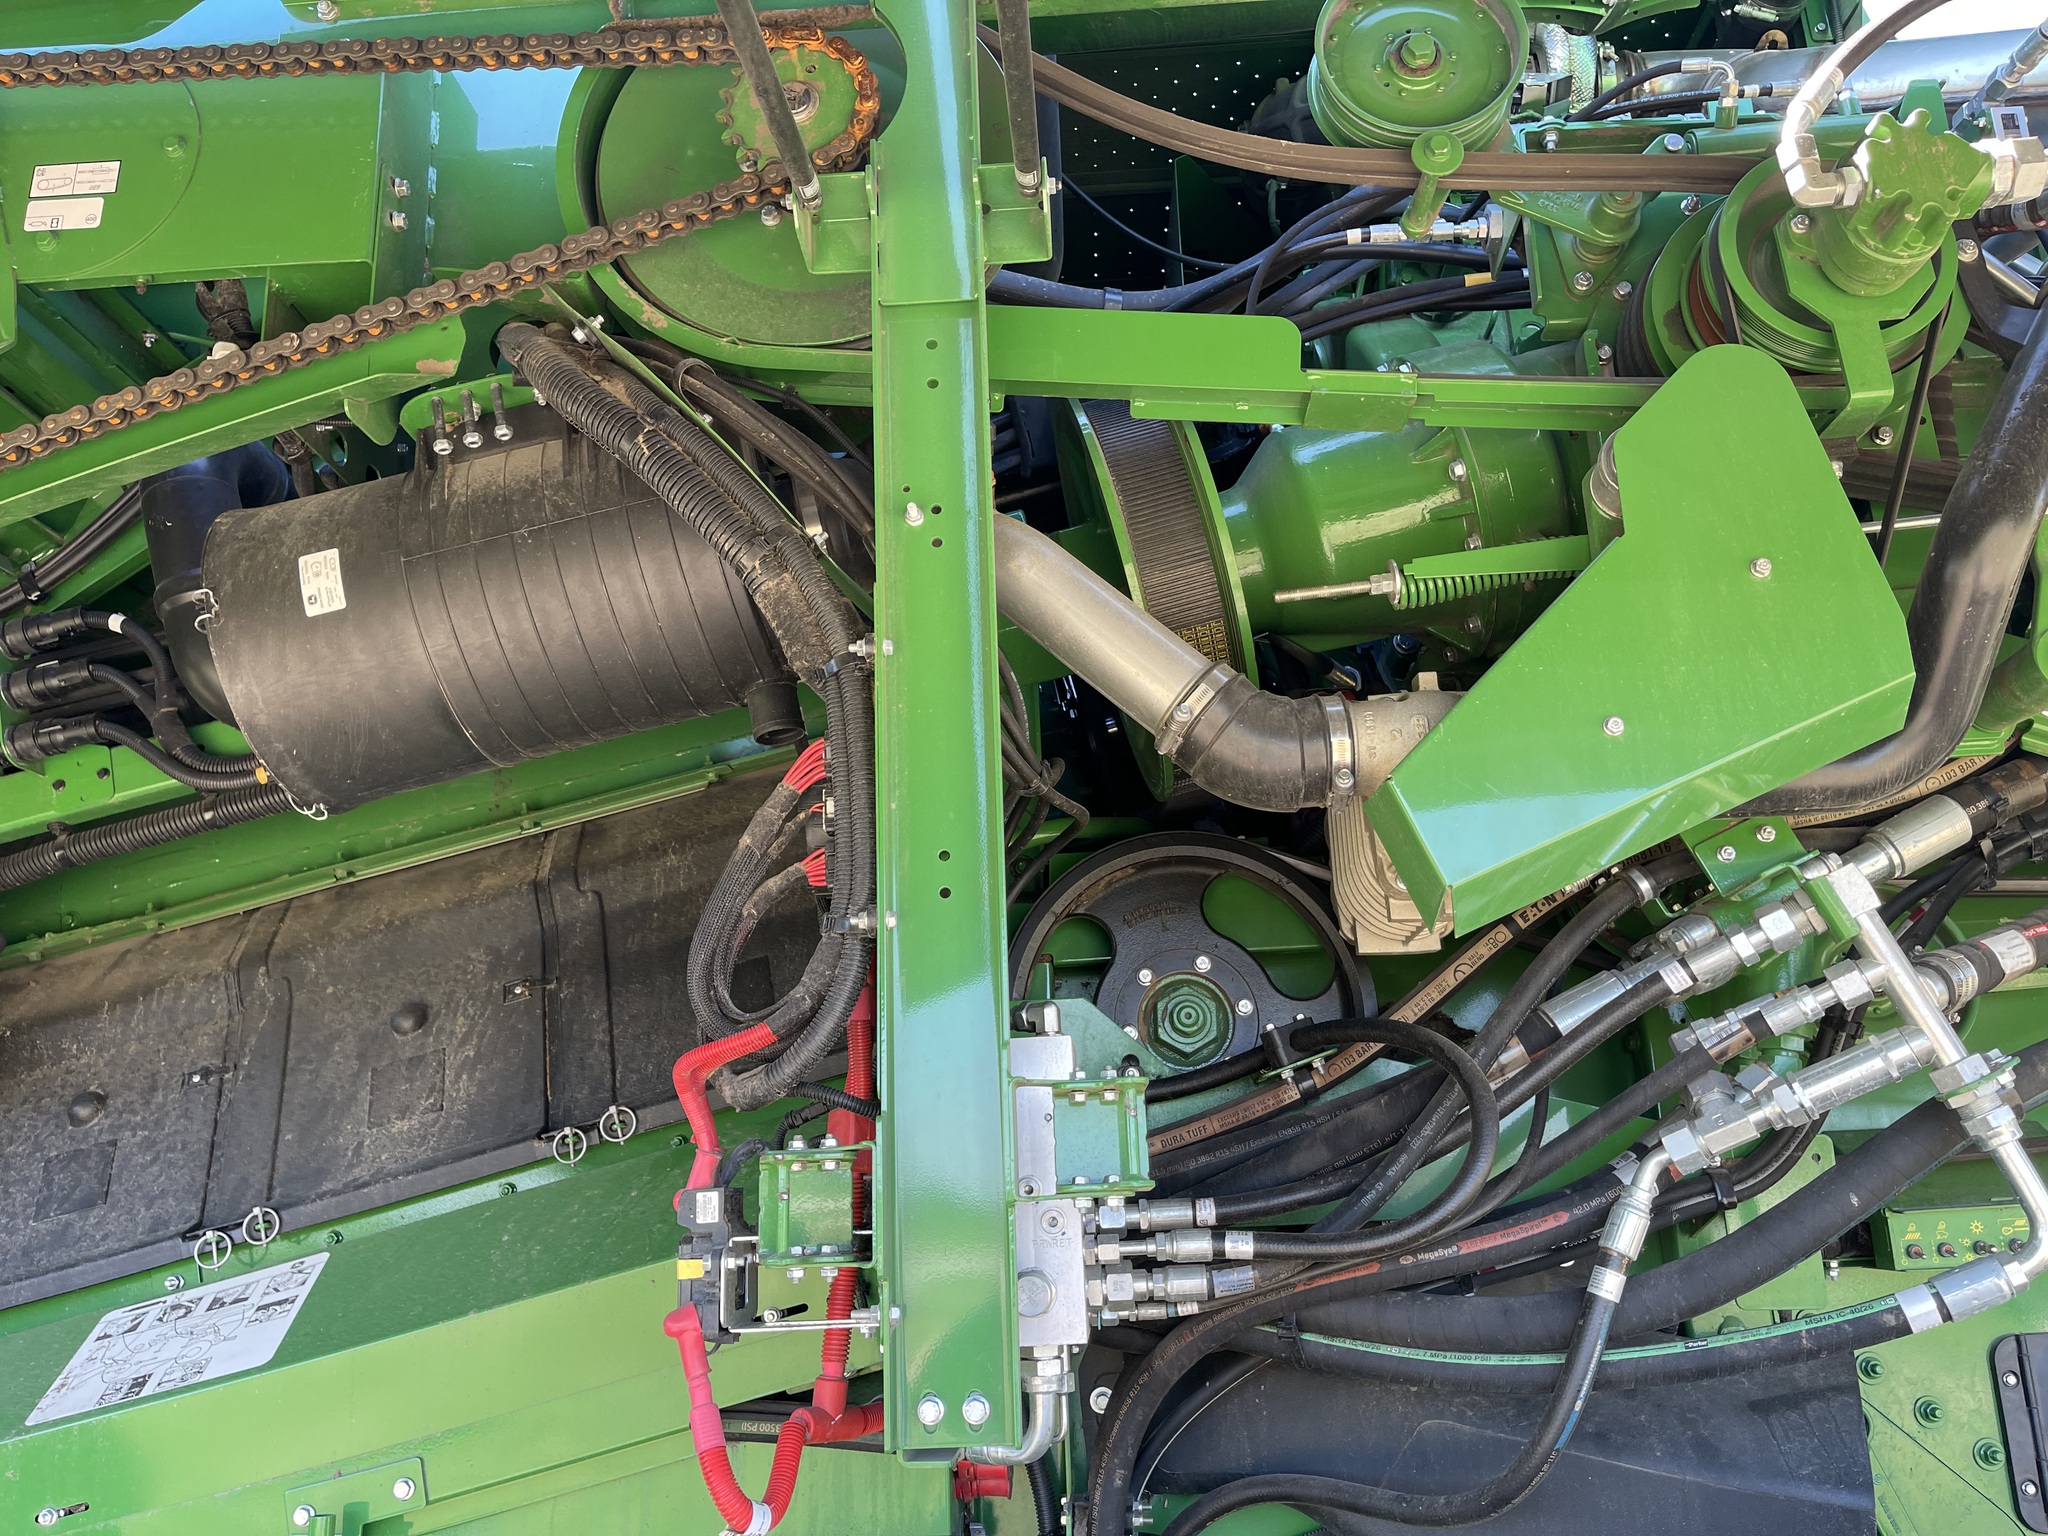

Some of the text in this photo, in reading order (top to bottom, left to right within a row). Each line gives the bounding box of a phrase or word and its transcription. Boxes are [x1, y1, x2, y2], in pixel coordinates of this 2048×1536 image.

[1940, 770, 1958, 785] 103
[1958, 758, 1978, 774] BAR
[1518, 893, 1558, 924] EATON
[1471, 954, 1485, 967] BEND
[1340, 1042, 1374, 1068] 103 BAR
[1196, 1153, 1215, 1164] 3862
[1215, 1148, 1230, 1158] R15
[1230, 1142, 1245, 1155] 4SH
[1250, 1134, 1278, 1147] Exceeds
[1277, 1123, 1301, 1138] EN856
[1301, 1119, 1316, 1130] R15
[1315, 1114, 1331, 1124] 4SH
[1375, 1181, 1385, 1192] KS
[1572, 1203, 1590, 1215] 42.0
[1588, 1195, 1607, 1207] MPa
[1192, 1319, 1214, 1335] Flame
[1212, 1301, 1245, 1322] Resistant
[1804, 1303, 1875, 1327] MSHA IC-40/26
[741, 1422, 758, 1432] PSI)
[1093, 1484, 1102, 1503] 3862
[1101, 1453, 1109, 1469] 4SH
[1106, 1419, 1121, 1448] Exceeds
[1118, 1397, 1132, 1422] EN856
[1130, 1383, 1141, 1399] R15
[1139, 1370, 1150, 1386] 4SH
[1151, 1356, 1163, 1370] SAE
